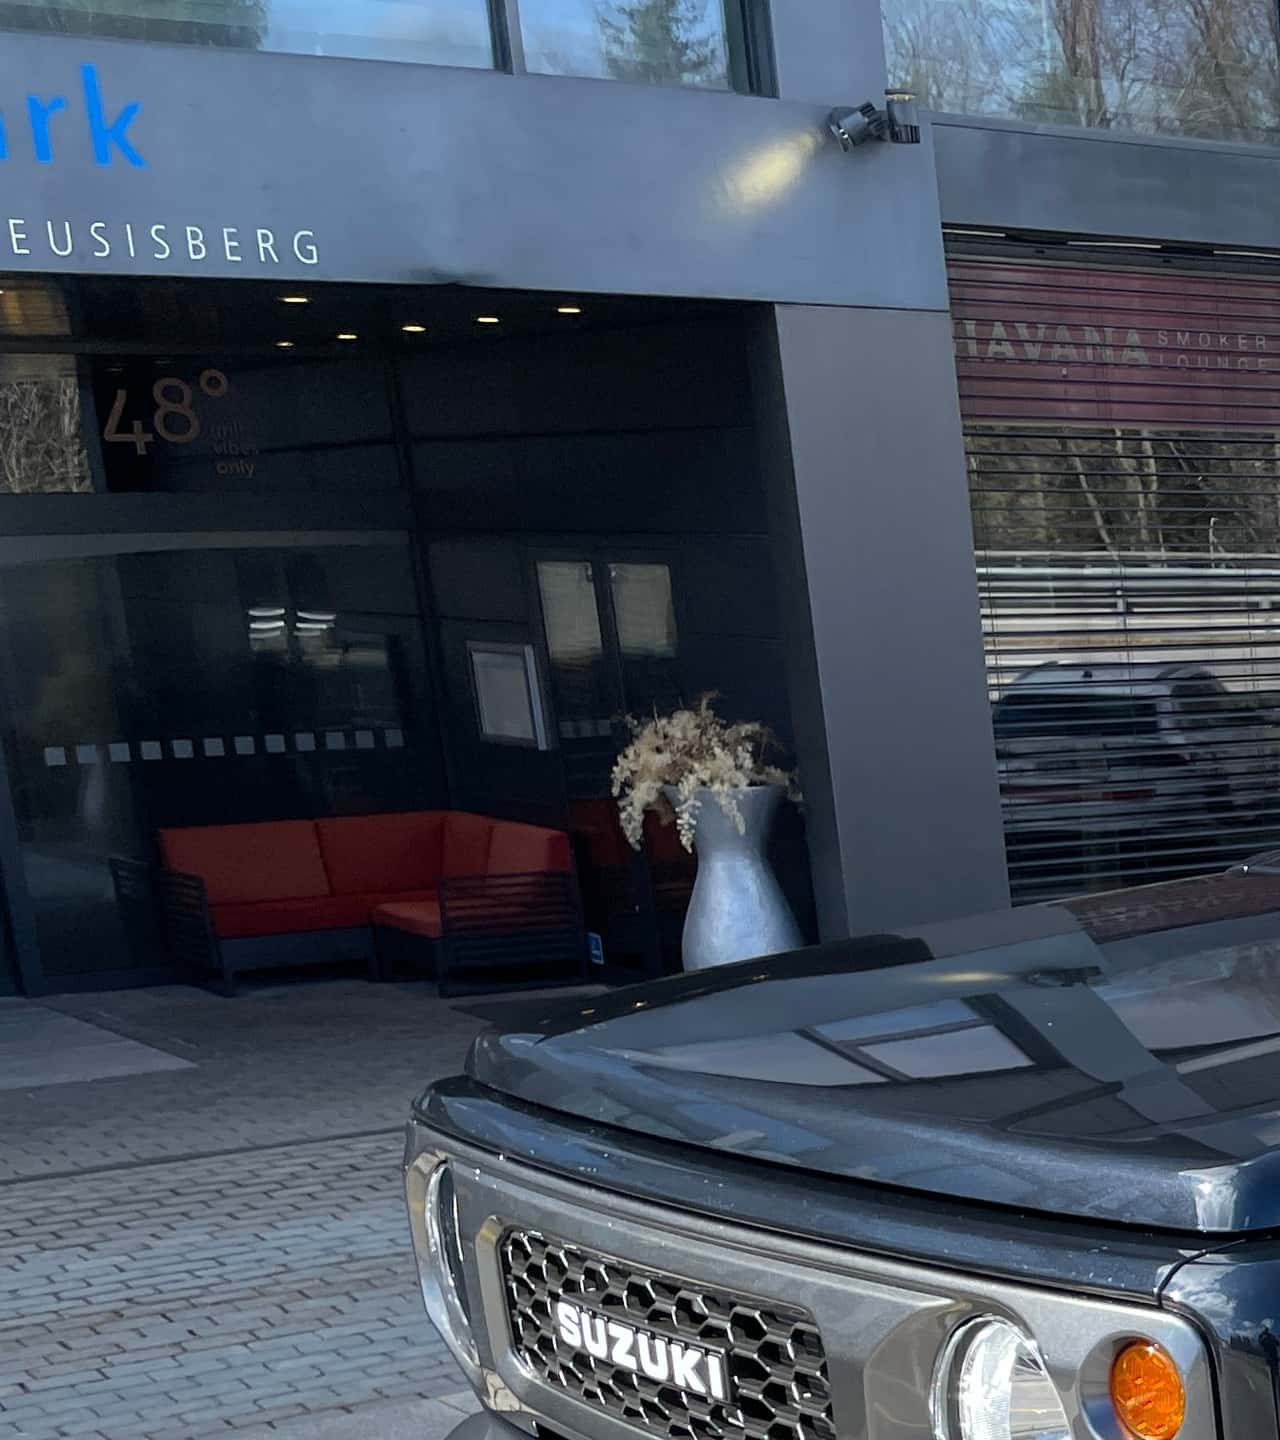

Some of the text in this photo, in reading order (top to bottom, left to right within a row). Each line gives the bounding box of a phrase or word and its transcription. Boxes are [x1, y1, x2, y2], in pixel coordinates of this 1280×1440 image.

[0, 64, 147, 168] rk
[9, 219, 320, 265] EUSISBERG
[1157, 331, 1268, 351] SMOKER
[216, 458, 255, 478] only
[557, 1301, 723, 1399] SUZUKI
